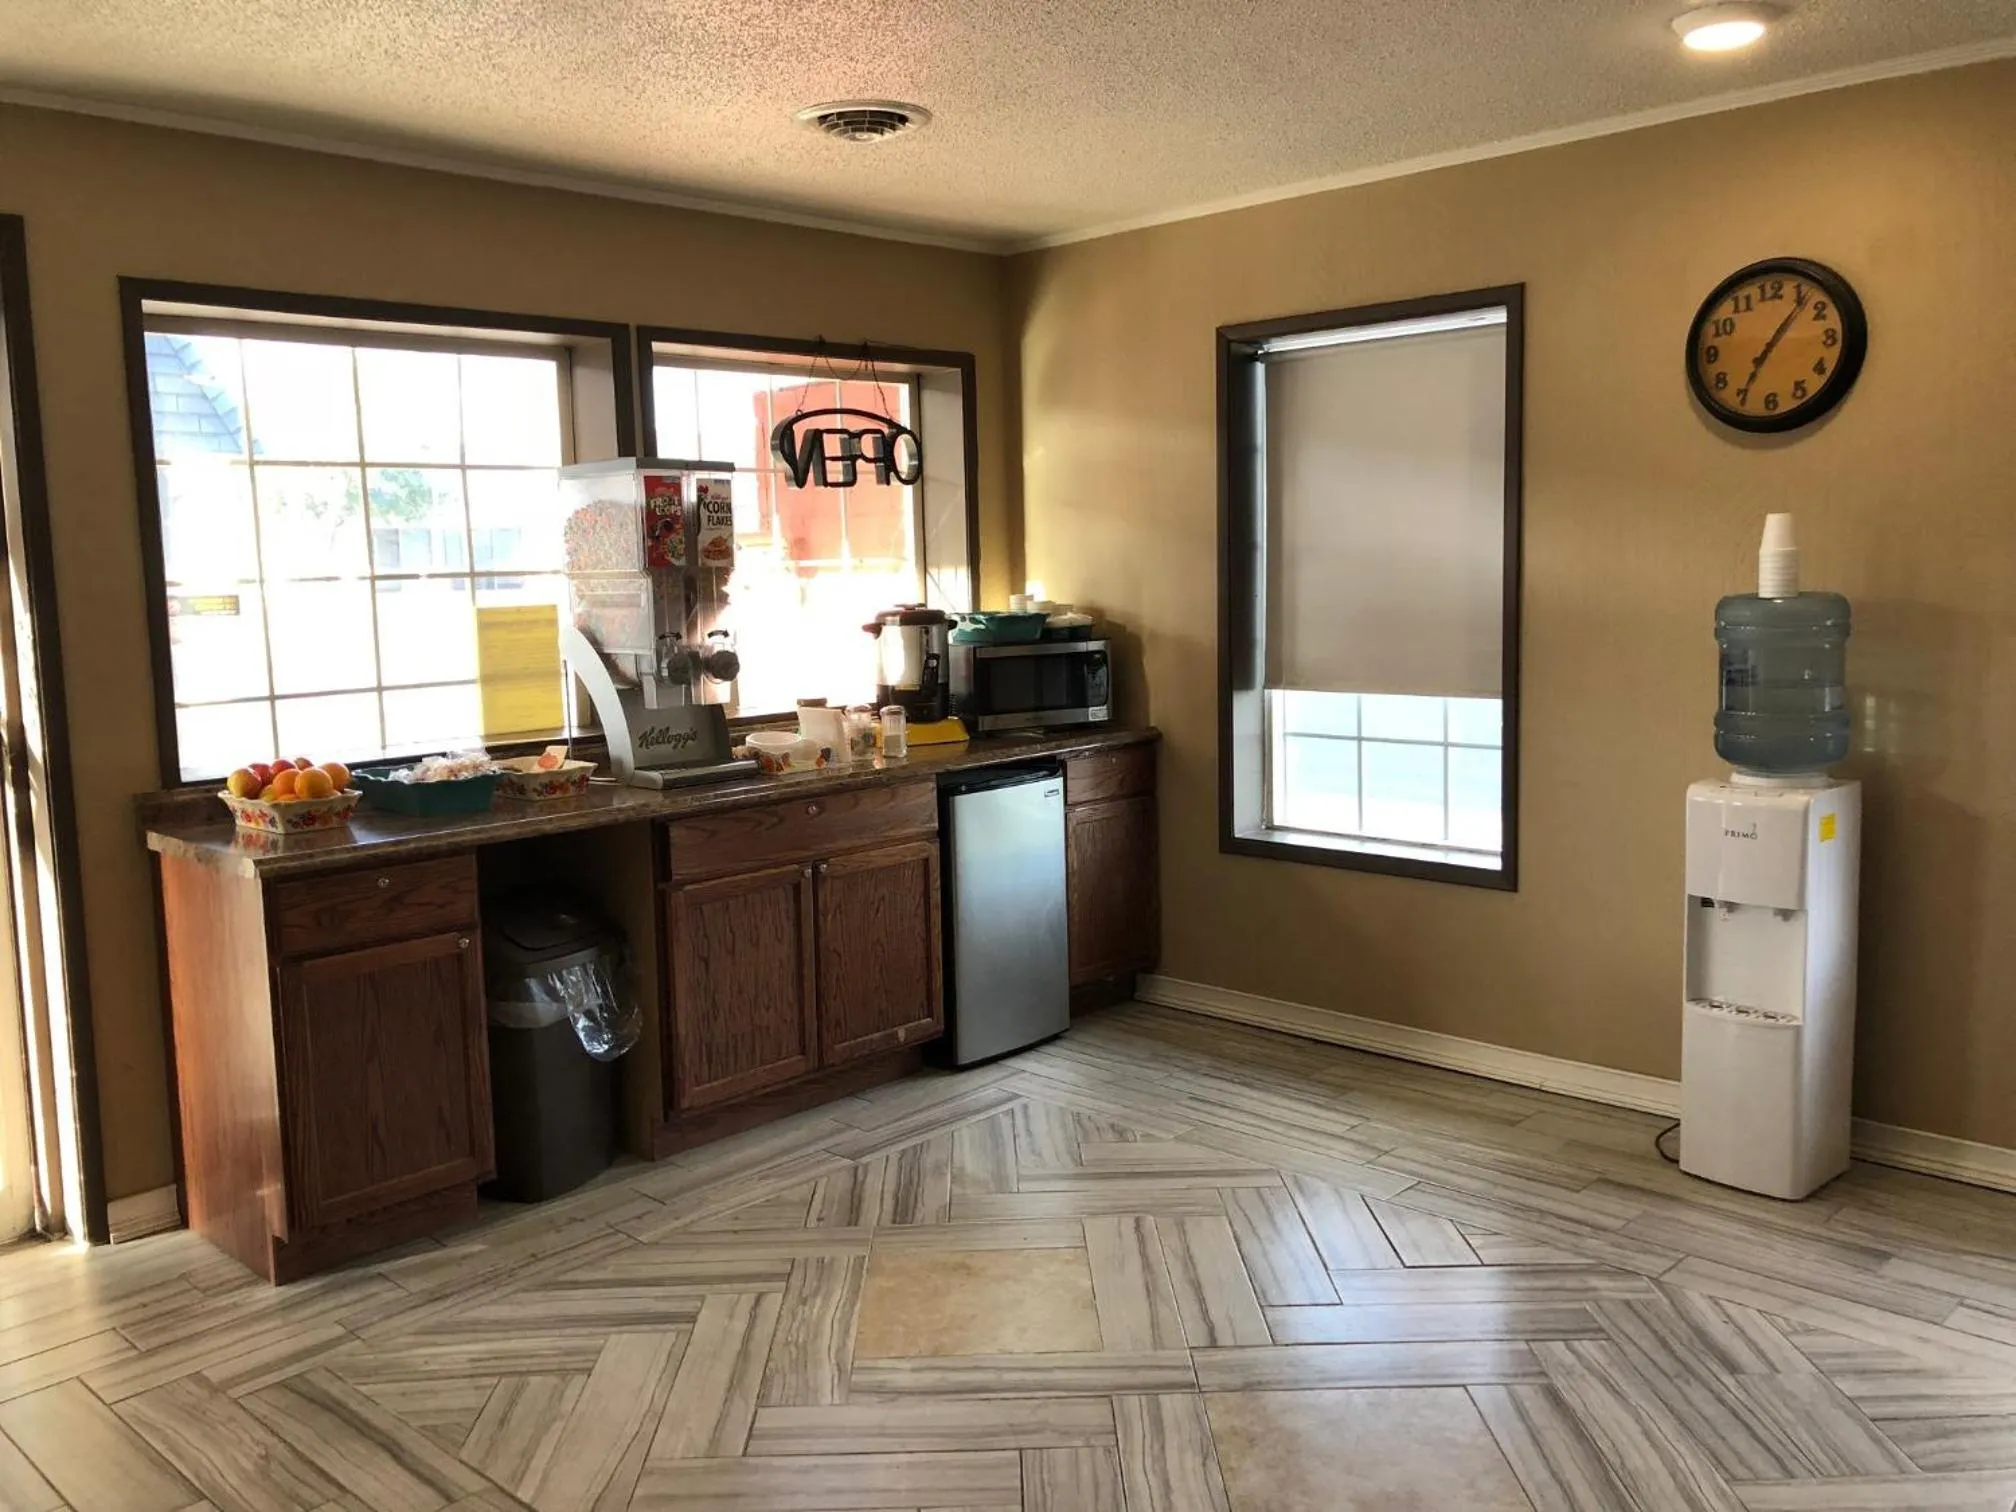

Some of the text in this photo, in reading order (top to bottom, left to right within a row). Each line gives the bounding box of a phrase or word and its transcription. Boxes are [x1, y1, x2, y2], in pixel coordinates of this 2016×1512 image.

[1757, 279, 1783, 302] 12
[1731, 293, 1753, 314] 11
[1812, 301, 1827, 321] 2
[1711, 317, 1736, 338] 10
[1705, 345, 1719, 364] 9
[1812, 356, 1827, 376] 4
[1714, 371, 1728, 390] 8
[1792, 379, 1807, 400] 5
[1736, 387, 1749, 407] 7
[1764, 392, 1779, 411] 6
[706, 500, 732, 514] CORN
[707, 515, 733, 527] FLAKES
[638, 725, 699, 750] Kellogg's
